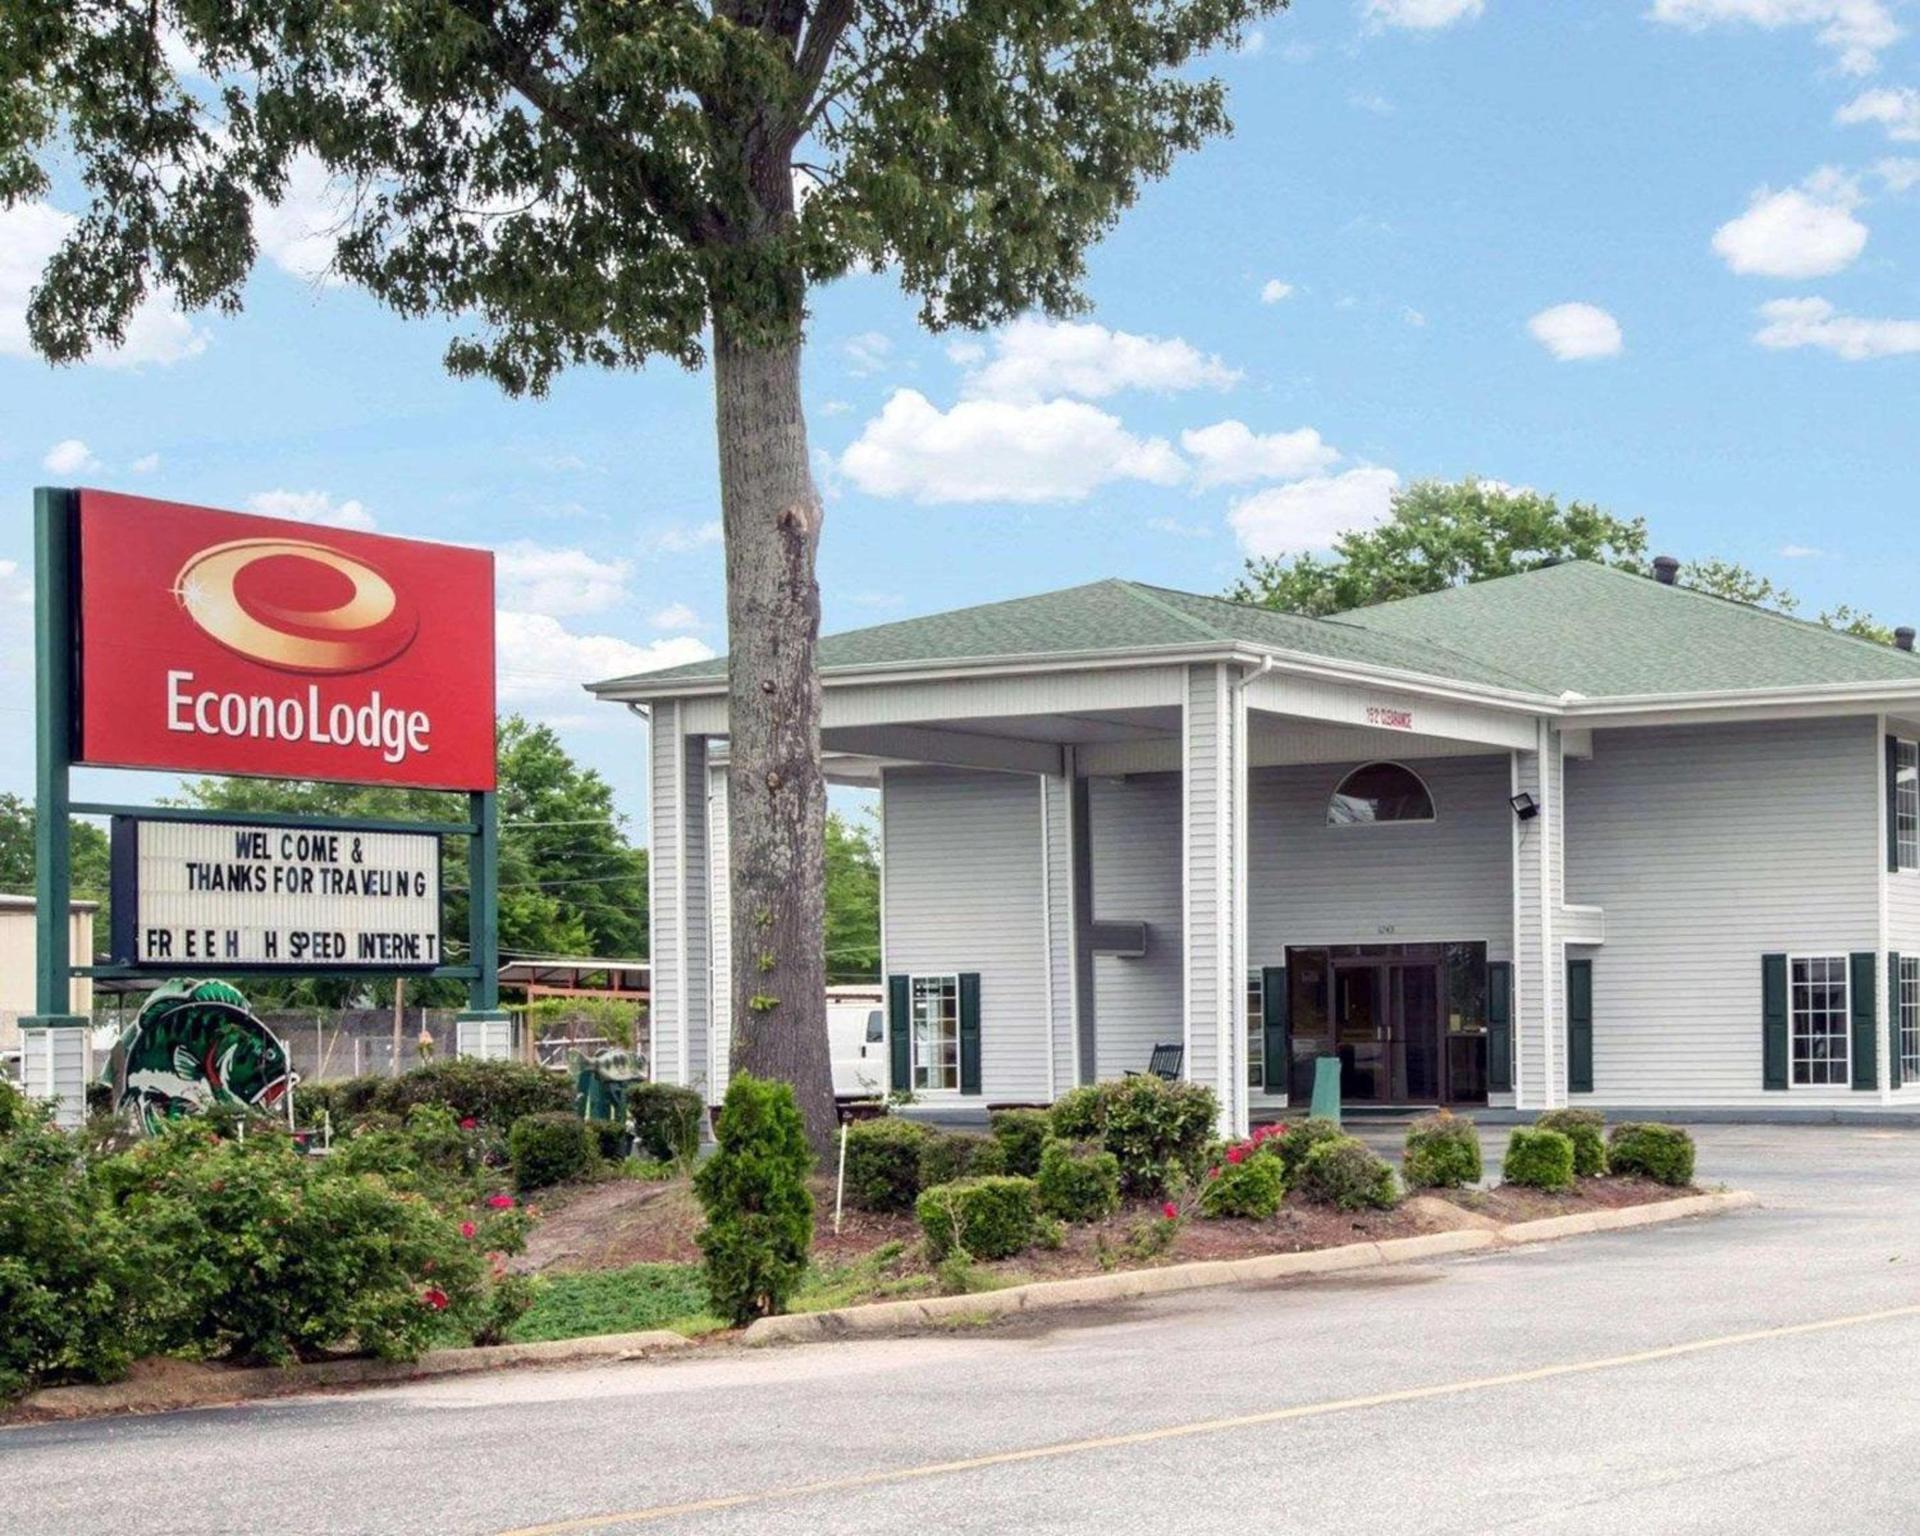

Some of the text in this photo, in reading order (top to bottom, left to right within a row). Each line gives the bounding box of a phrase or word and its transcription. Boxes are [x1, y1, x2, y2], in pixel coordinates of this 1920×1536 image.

[235, 832, 363, 863] WELCOME &
[186, 863, 426, 897] THANKS FOR TRAVELING
[147, 929, 215, 957] FREE
[290, 931, 345, 959] SPEED
[358, 933, 436, 959] INTERNET
